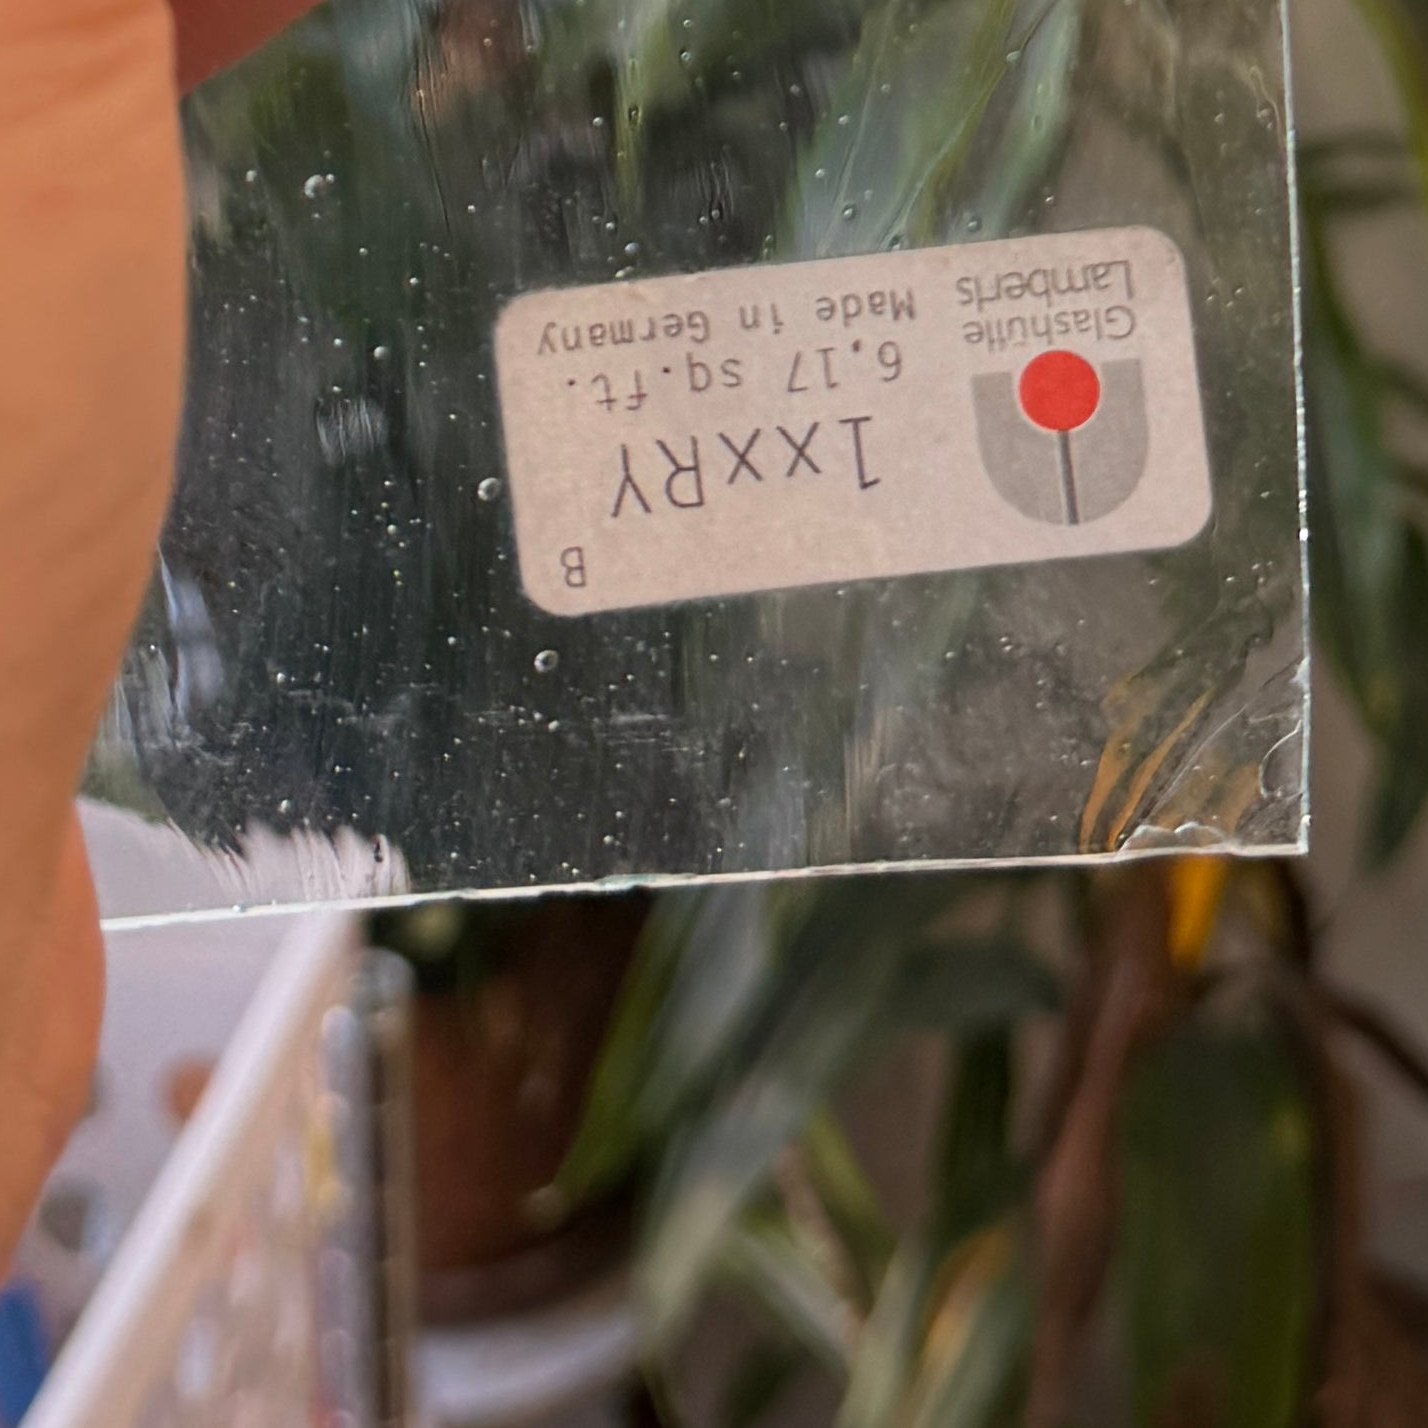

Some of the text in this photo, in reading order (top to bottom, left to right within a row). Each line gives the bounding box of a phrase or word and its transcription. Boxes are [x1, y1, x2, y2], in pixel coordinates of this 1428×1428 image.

[955, 258, 1135, 311] Lamberts
[537, 287, 917, 355] Made in Germany
[961, 304, 1138, 352] Glashütte
[566, 351, 744, 412] sq.ft.
[610, 415, 881, 519] 1xxRY
[559, 546, 587, 588] B
